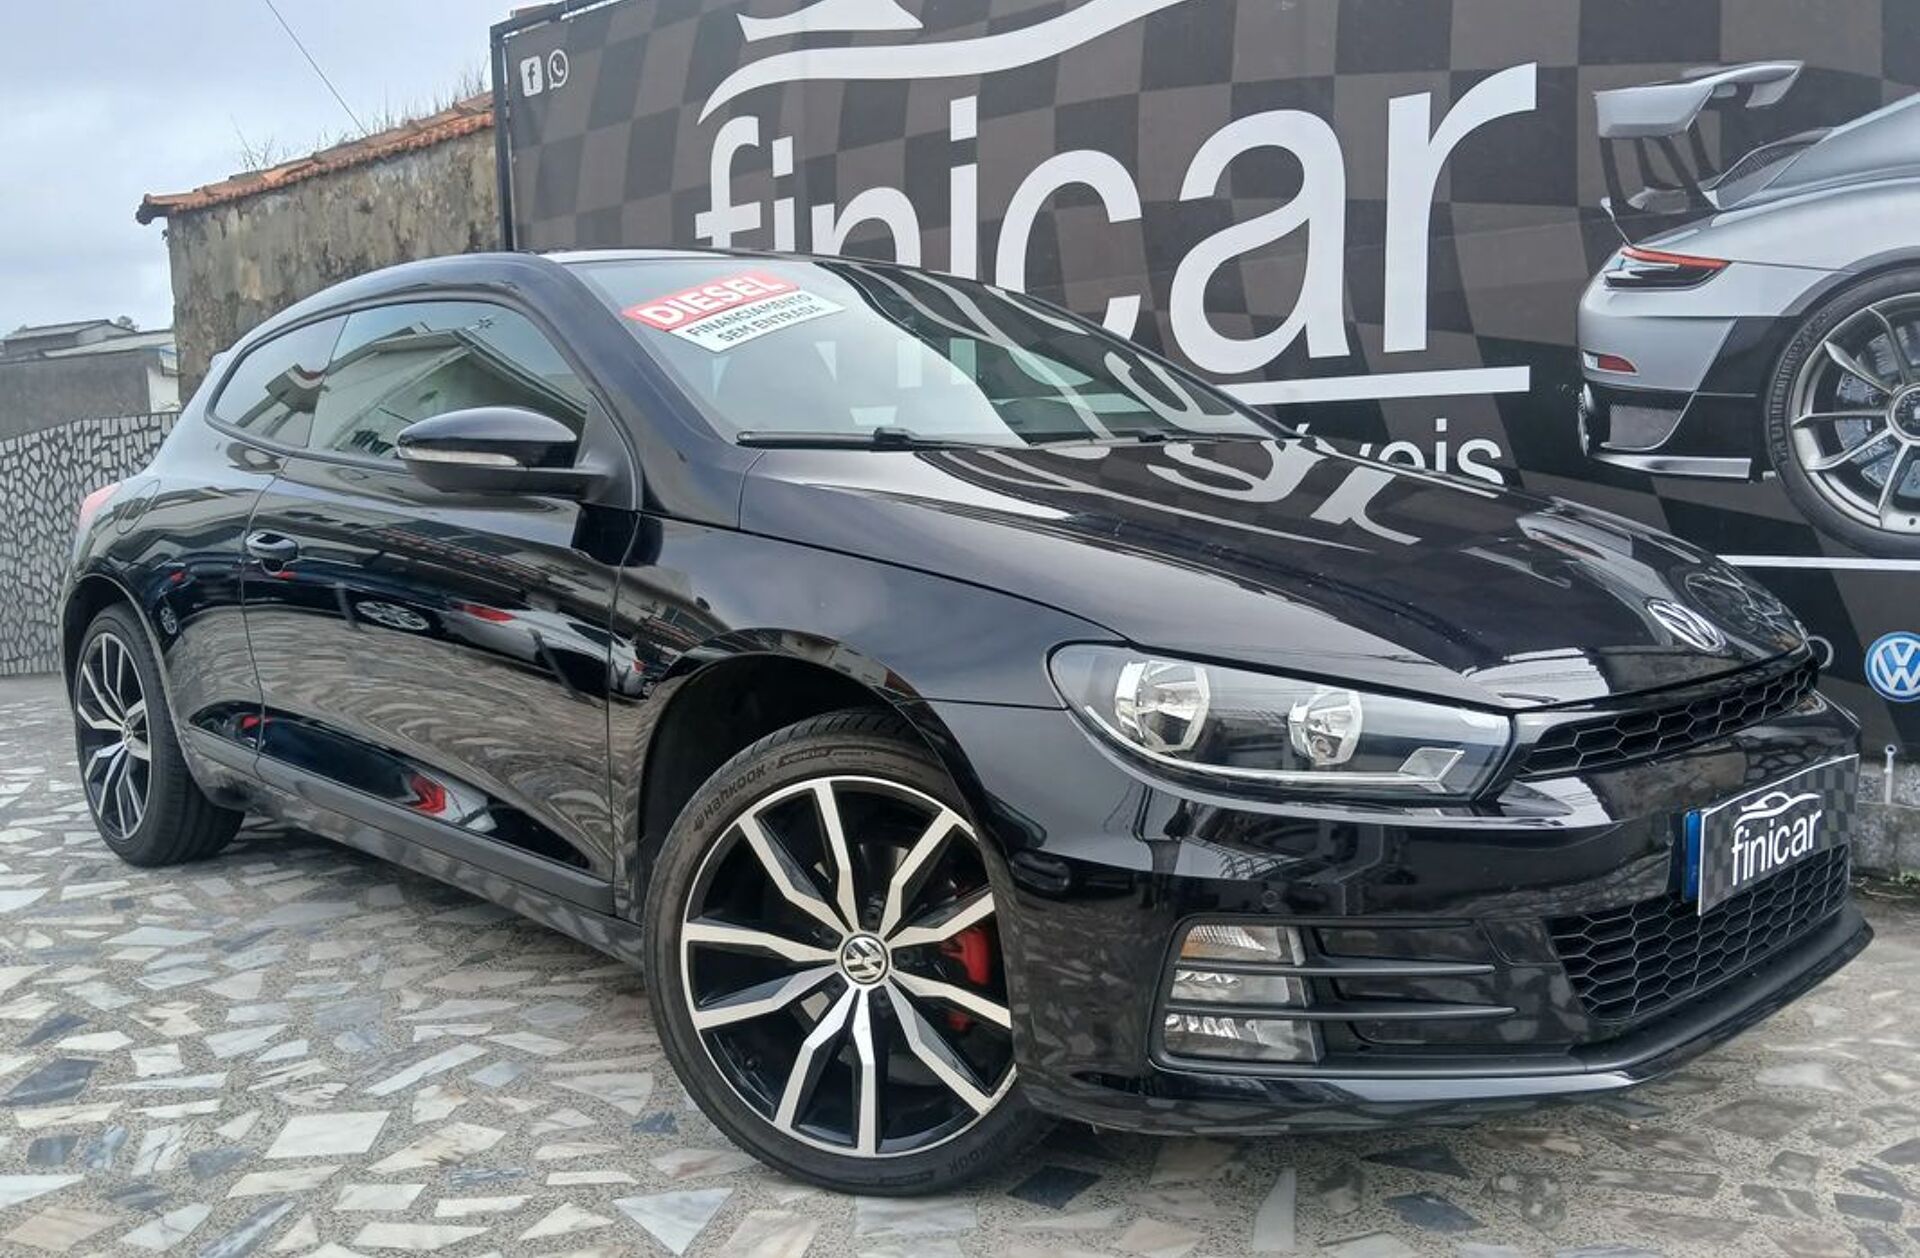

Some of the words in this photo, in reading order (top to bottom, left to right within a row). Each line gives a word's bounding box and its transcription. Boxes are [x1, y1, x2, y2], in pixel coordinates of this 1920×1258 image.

[694, 62, 1537, 375] finicar
[639, 276, 788, 325] DIESEL
[686, 293, 813, 337] FINANCIAMENTO
[717, 324, 752, 342] SEM
[751, 303, 823, 331] ENTRADA
[1731, 809, 1823, 887] finicar
